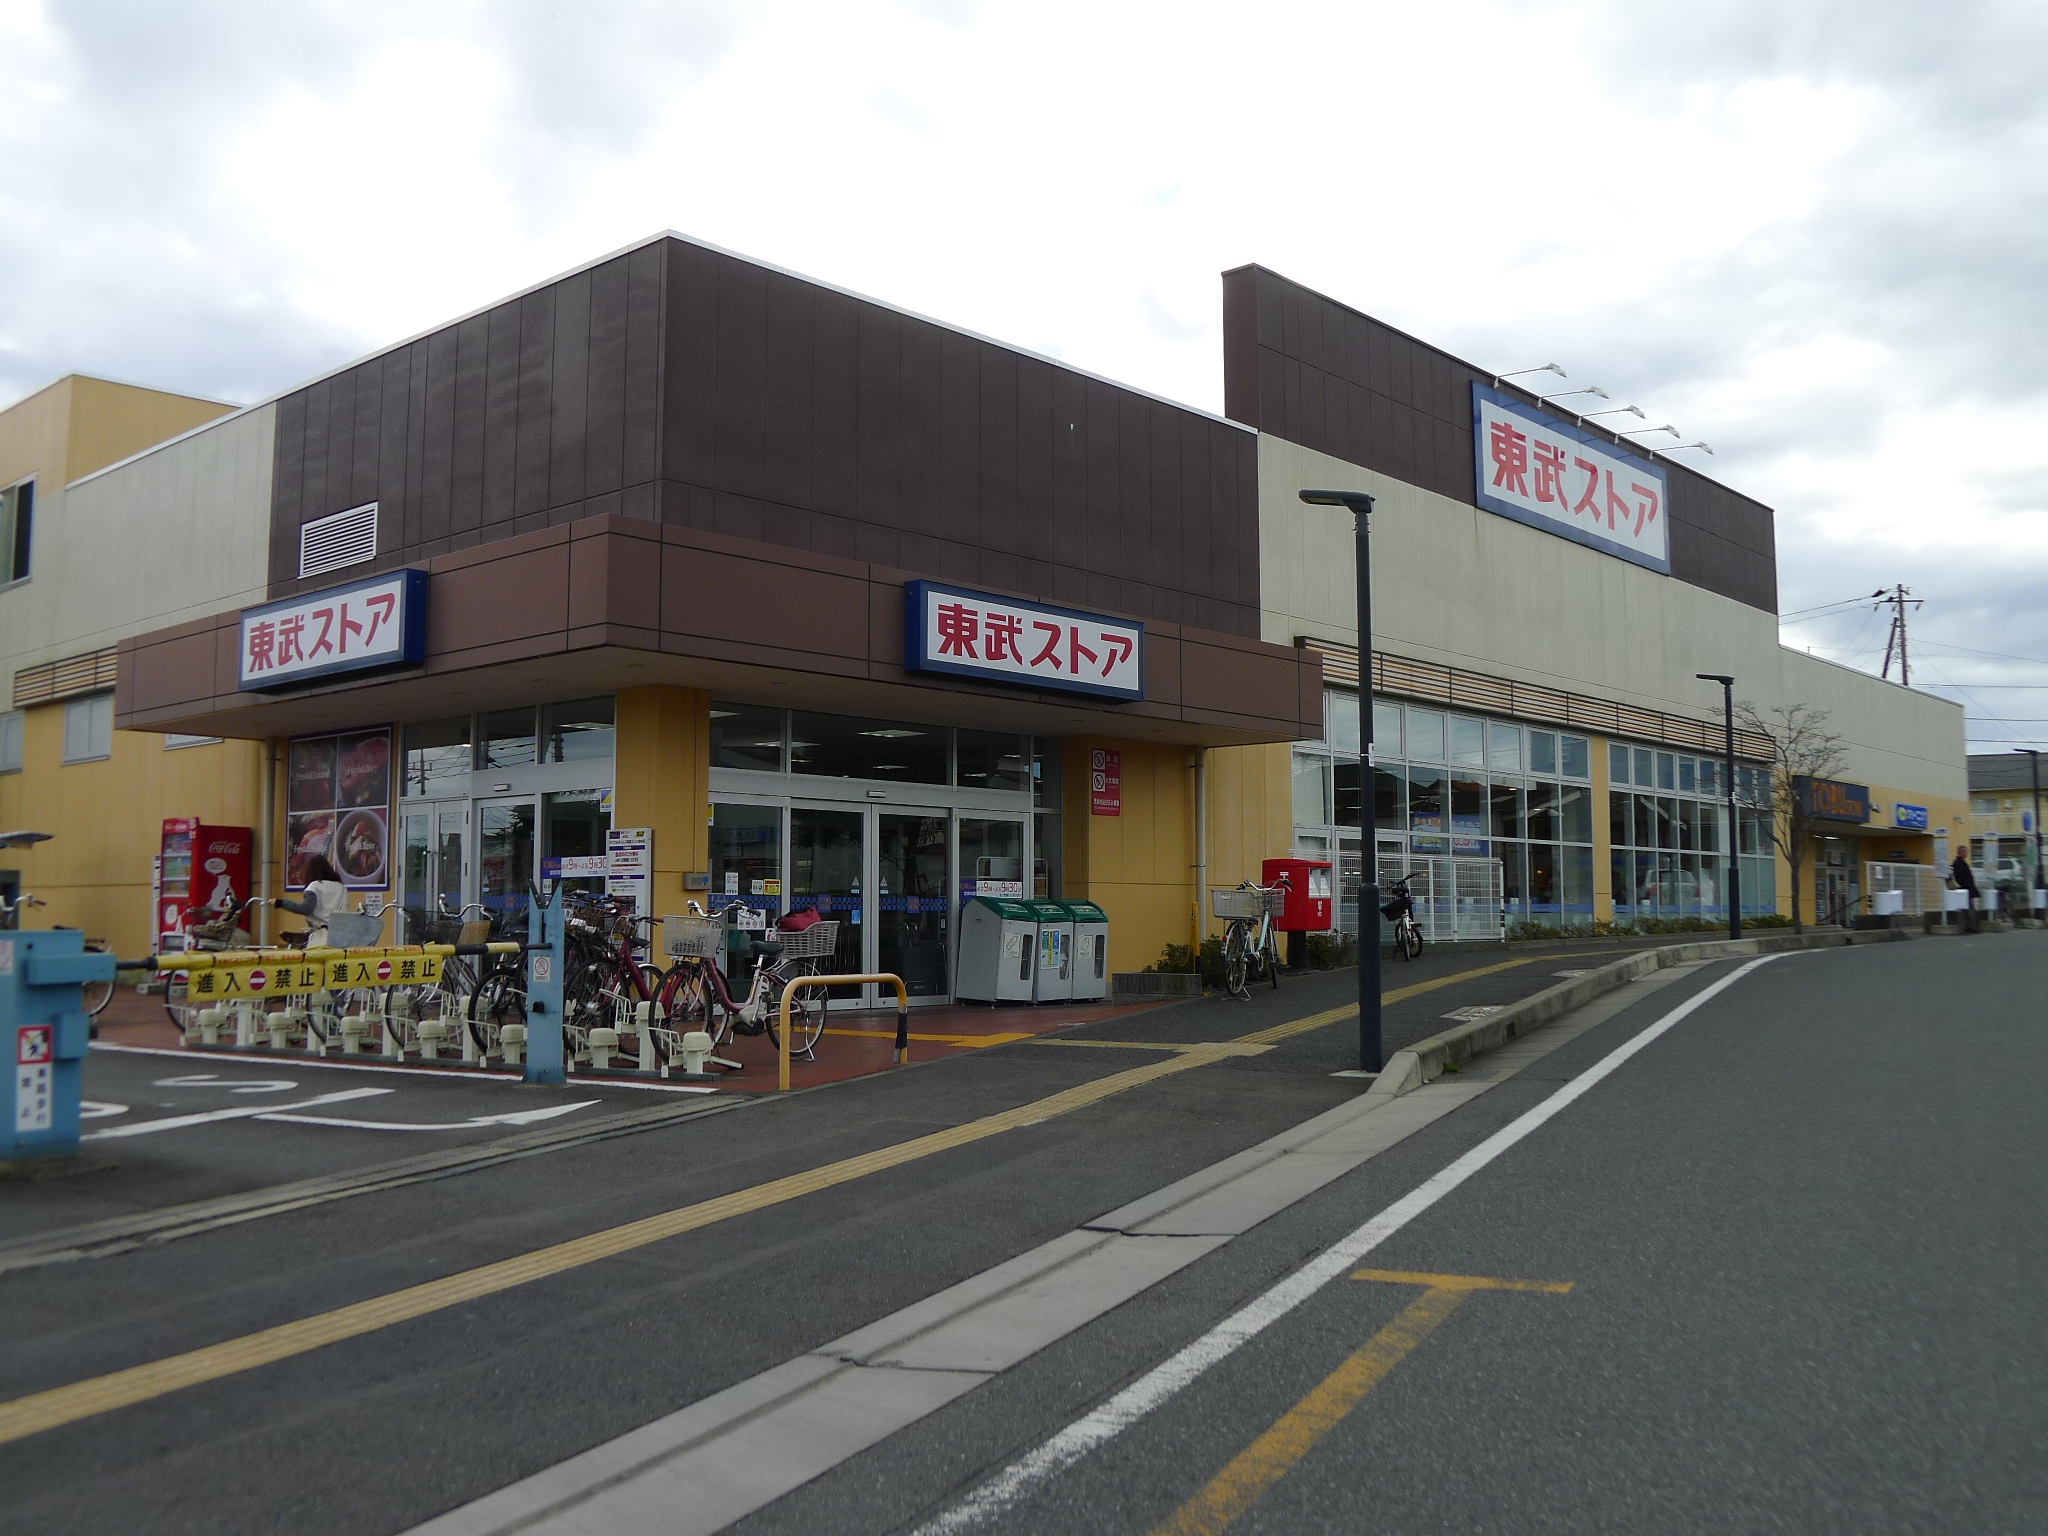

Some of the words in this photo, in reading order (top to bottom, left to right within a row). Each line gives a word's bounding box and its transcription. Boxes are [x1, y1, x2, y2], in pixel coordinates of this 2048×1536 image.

[1490, 420, 1658, 538] 東武ストア
[248, 592, 396, 673] 東武ストア
[937, 603, 1133, 678] 東武ストア
[196, 970, 241, 994] 進入
[274, 967, 315, 989] 禁止
[332, 962, 371, 983] 進入
[400, 958, 436, 979] 禁止
